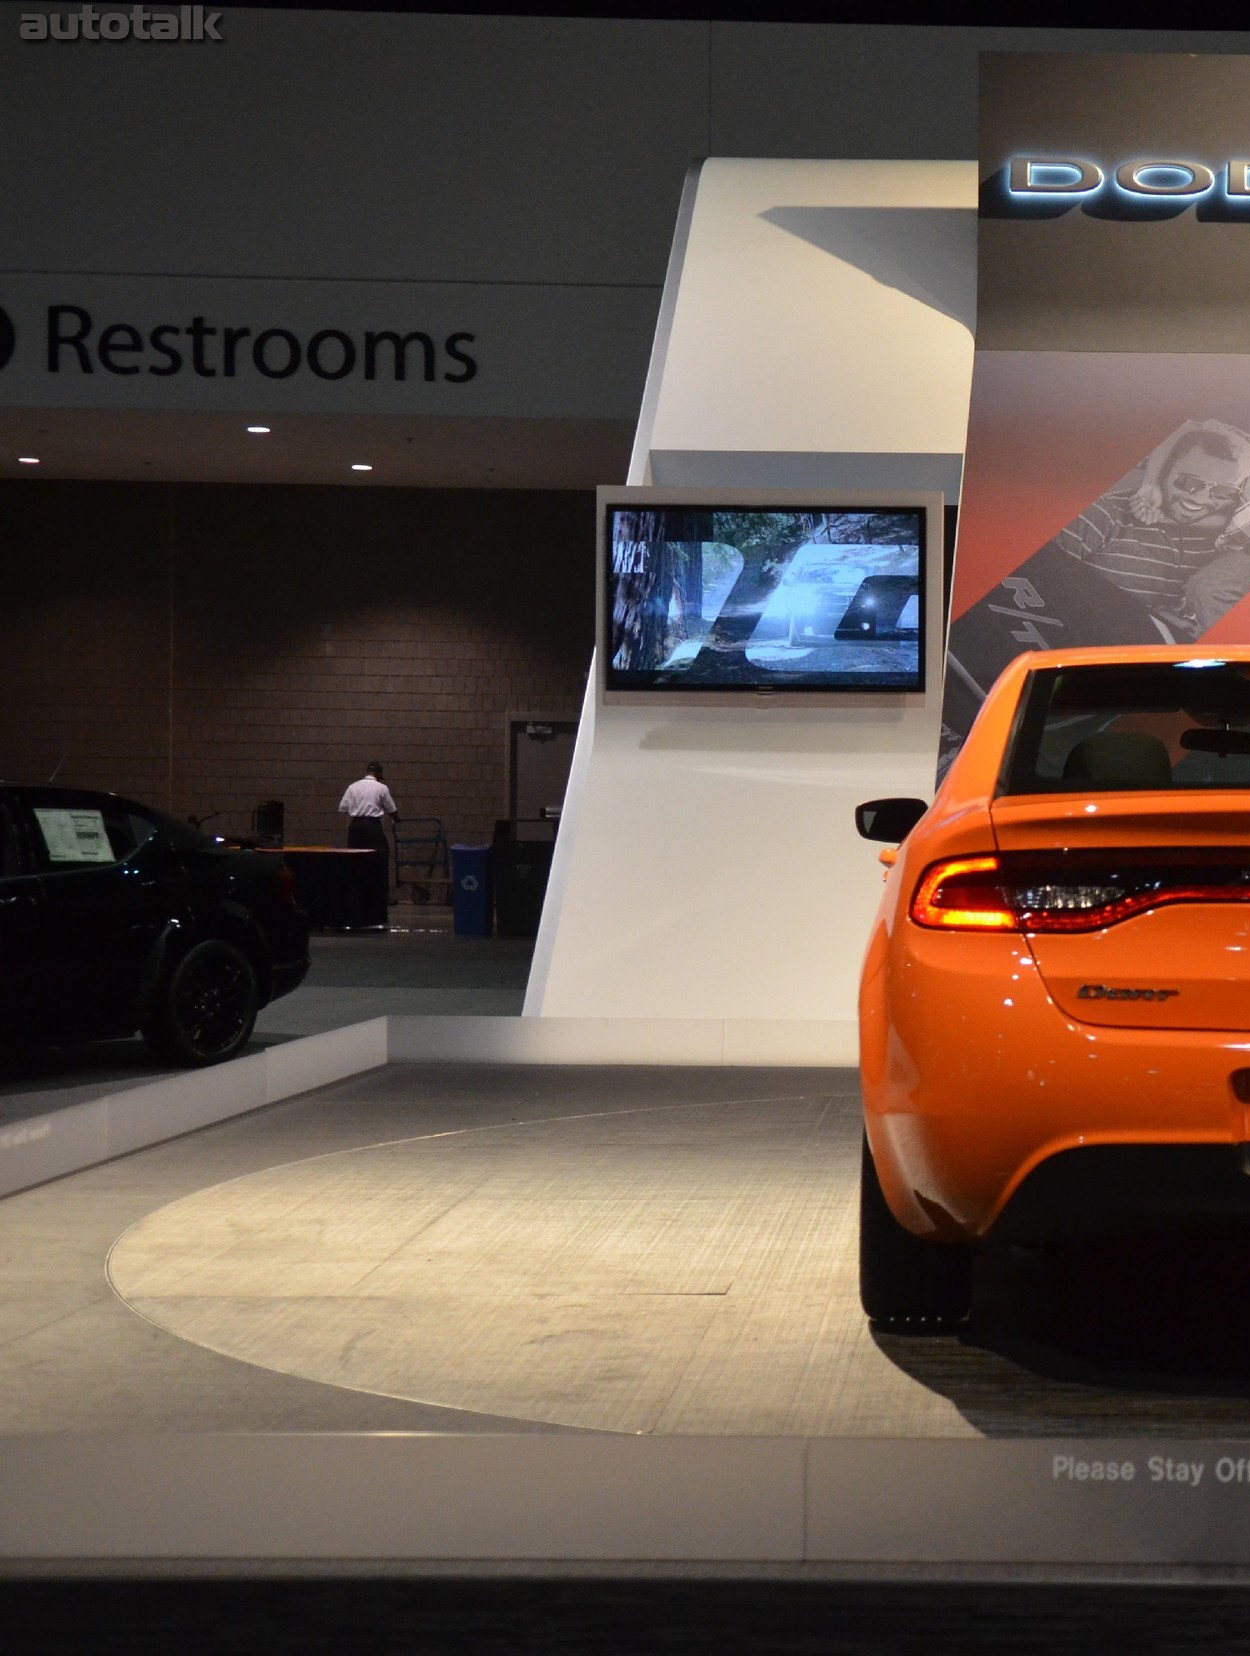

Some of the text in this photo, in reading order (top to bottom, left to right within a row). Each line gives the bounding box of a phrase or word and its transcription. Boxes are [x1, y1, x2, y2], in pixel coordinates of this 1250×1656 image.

[46, 304, 479, 384] Restrooms
[1052, 1455, 1136, 1482] Please
[1147, 1455, 1205, 1487] Stay
